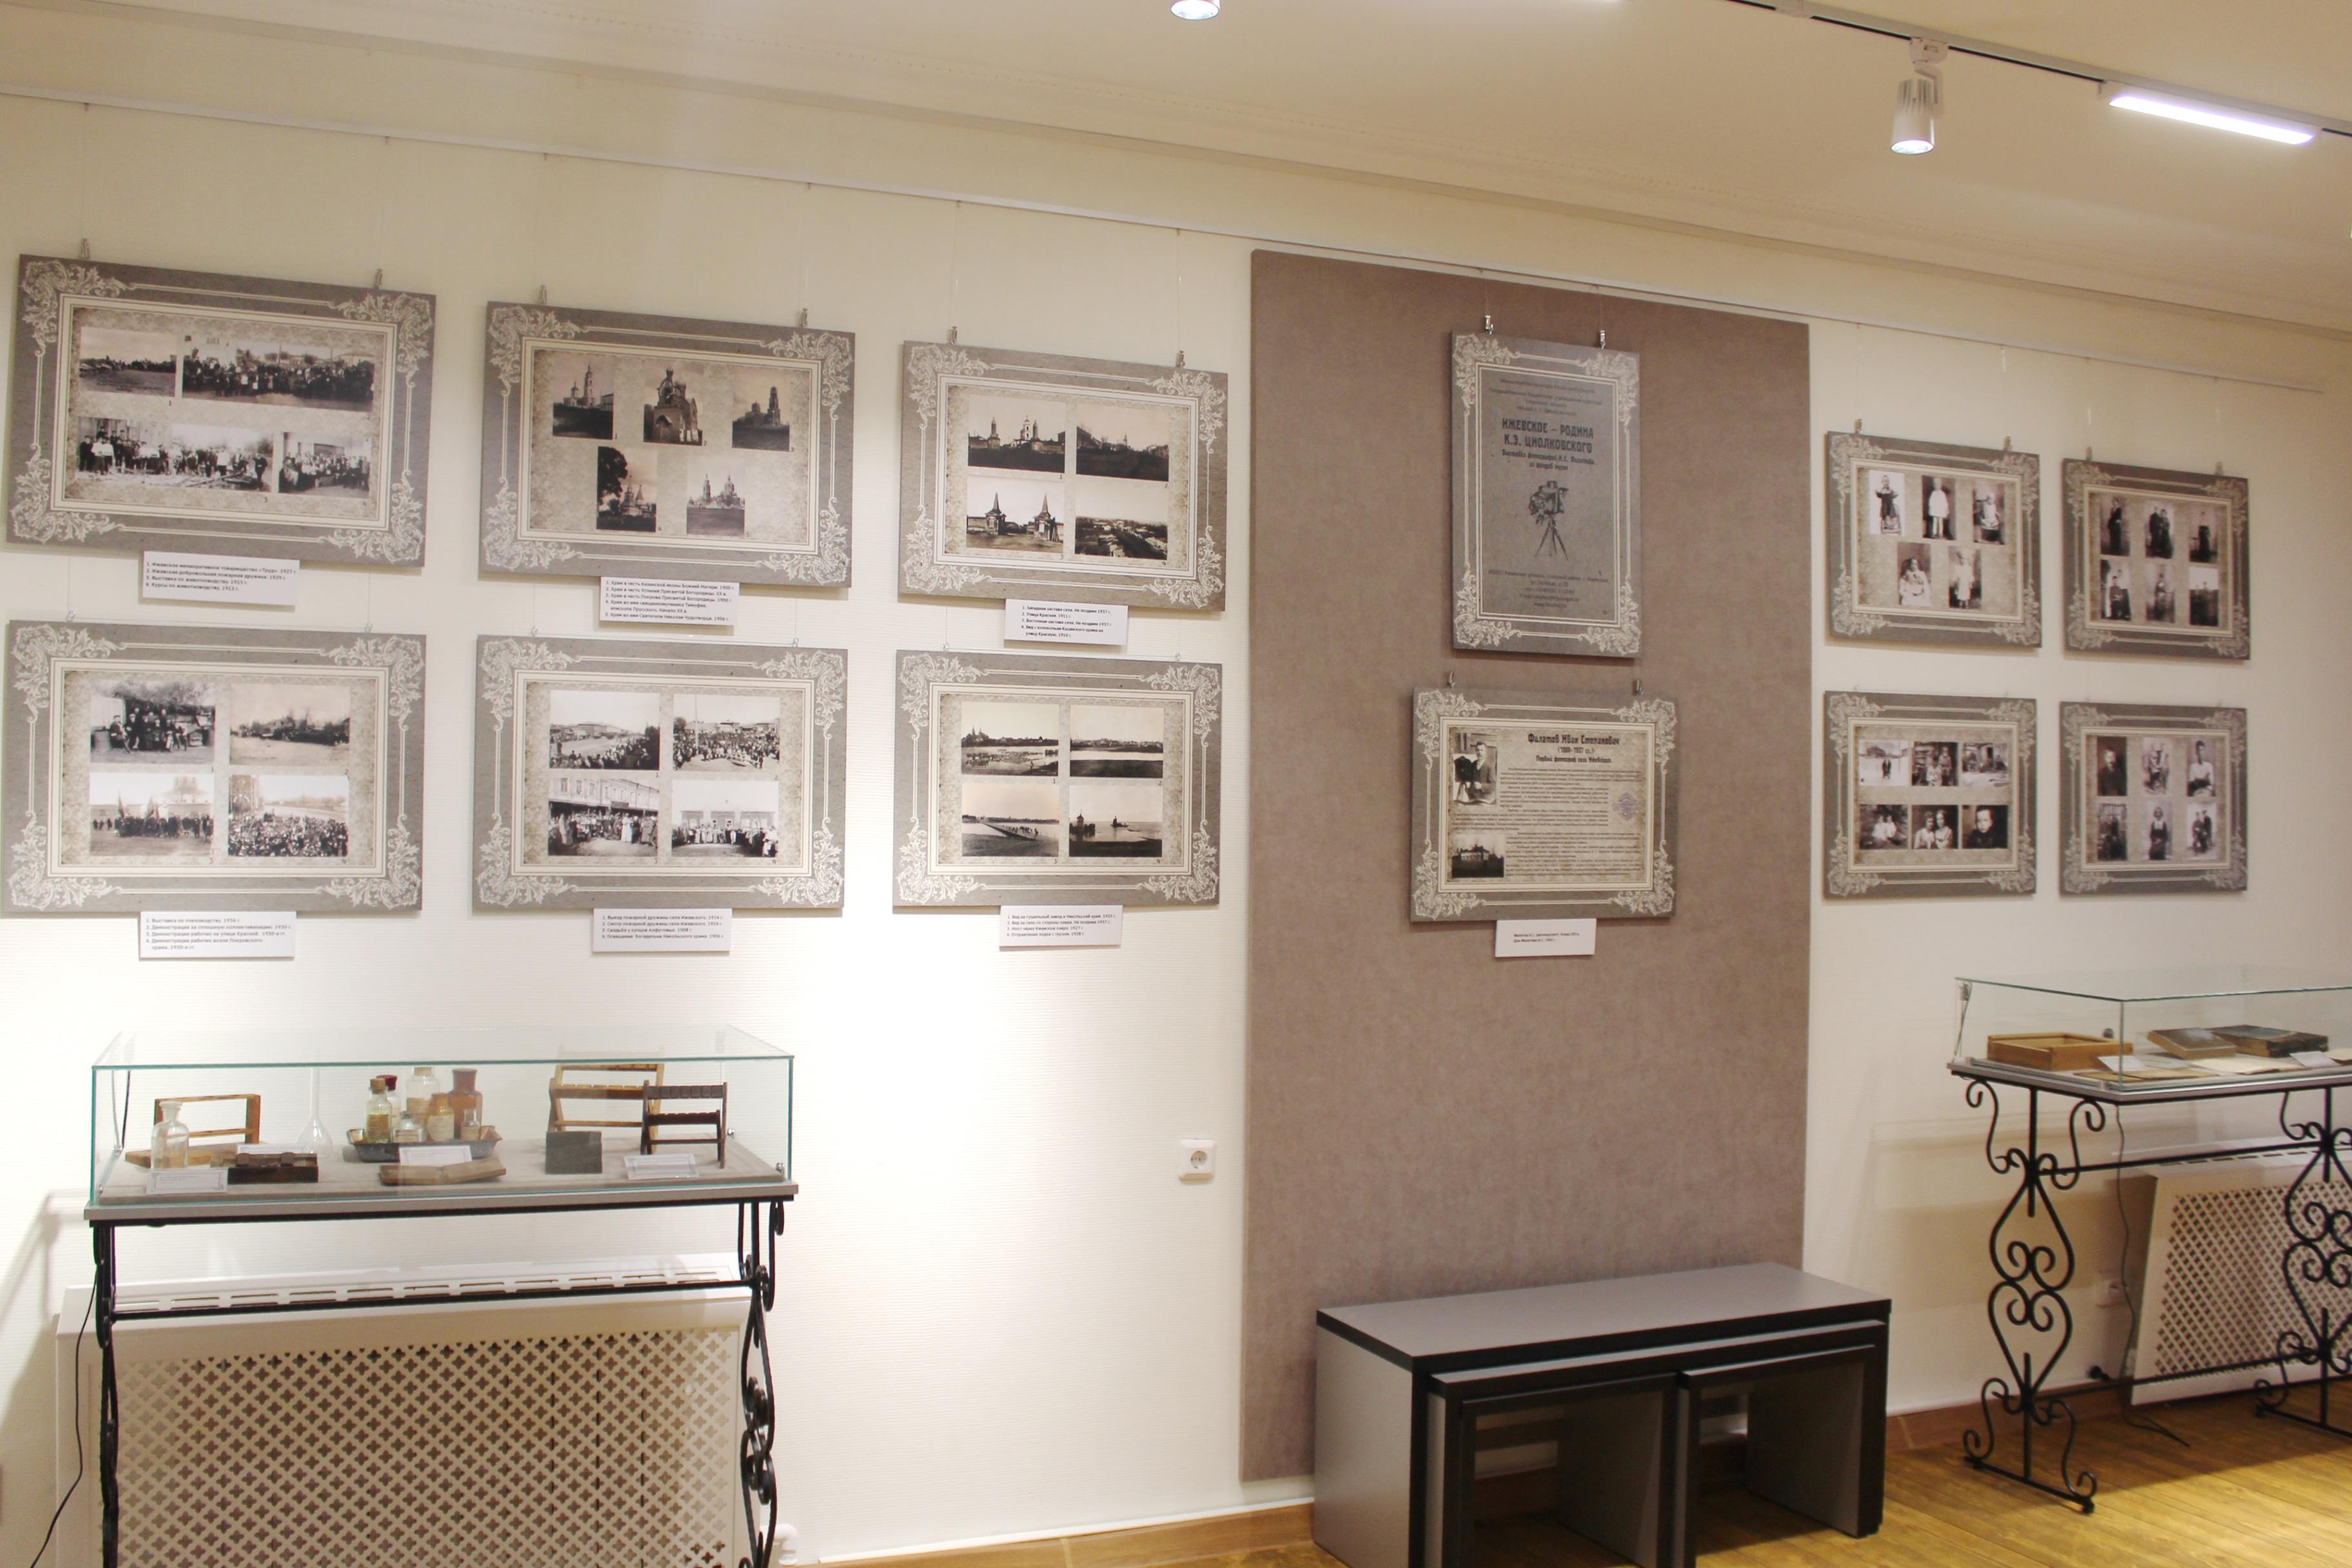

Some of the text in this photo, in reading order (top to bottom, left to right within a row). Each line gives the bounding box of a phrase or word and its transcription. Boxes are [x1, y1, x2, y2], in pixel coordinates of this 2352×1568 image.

[1502, 418, 1548, 433] ИЖЕВСКОЕ
[1560, 424, 1594, 439] РОДИНА
[1504, 433, 1592, 453] К.Э. ЦИОЛКОВСКОГО
[1528, 732, 1620, 745] Филатов Иван Степанович
